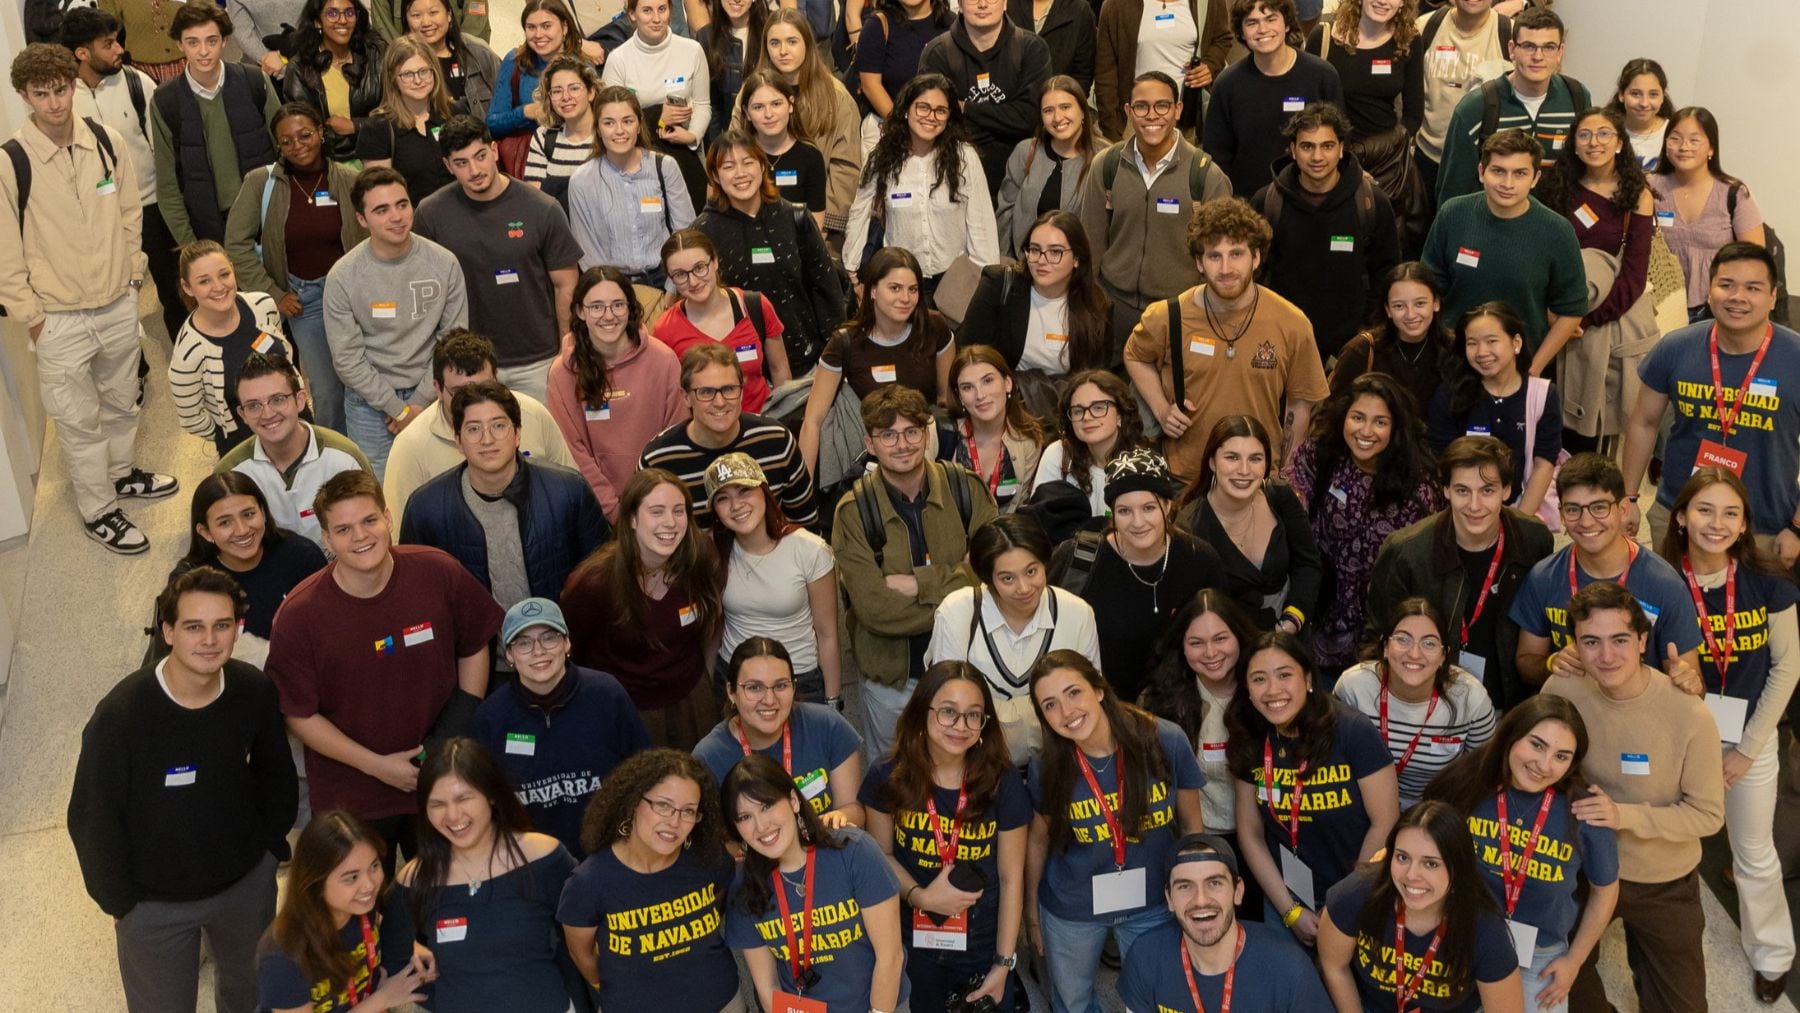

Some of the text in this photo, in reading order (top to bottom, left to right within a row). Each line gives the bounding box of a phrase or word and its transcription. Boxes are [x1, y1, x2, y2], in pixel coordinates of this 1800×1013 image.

[410, 280, 441, 320] P
[715, 461, 733, 481] LA
[1703, 452, 1738, 469] FRANCO
[410, 623, 424, 631] HELLO
[513, 776, 602, 806] NAVARRA
[606, 882, 716, 931] UNIVERSIDAD
[609, 906, 721, 956] DE NAVARRA
